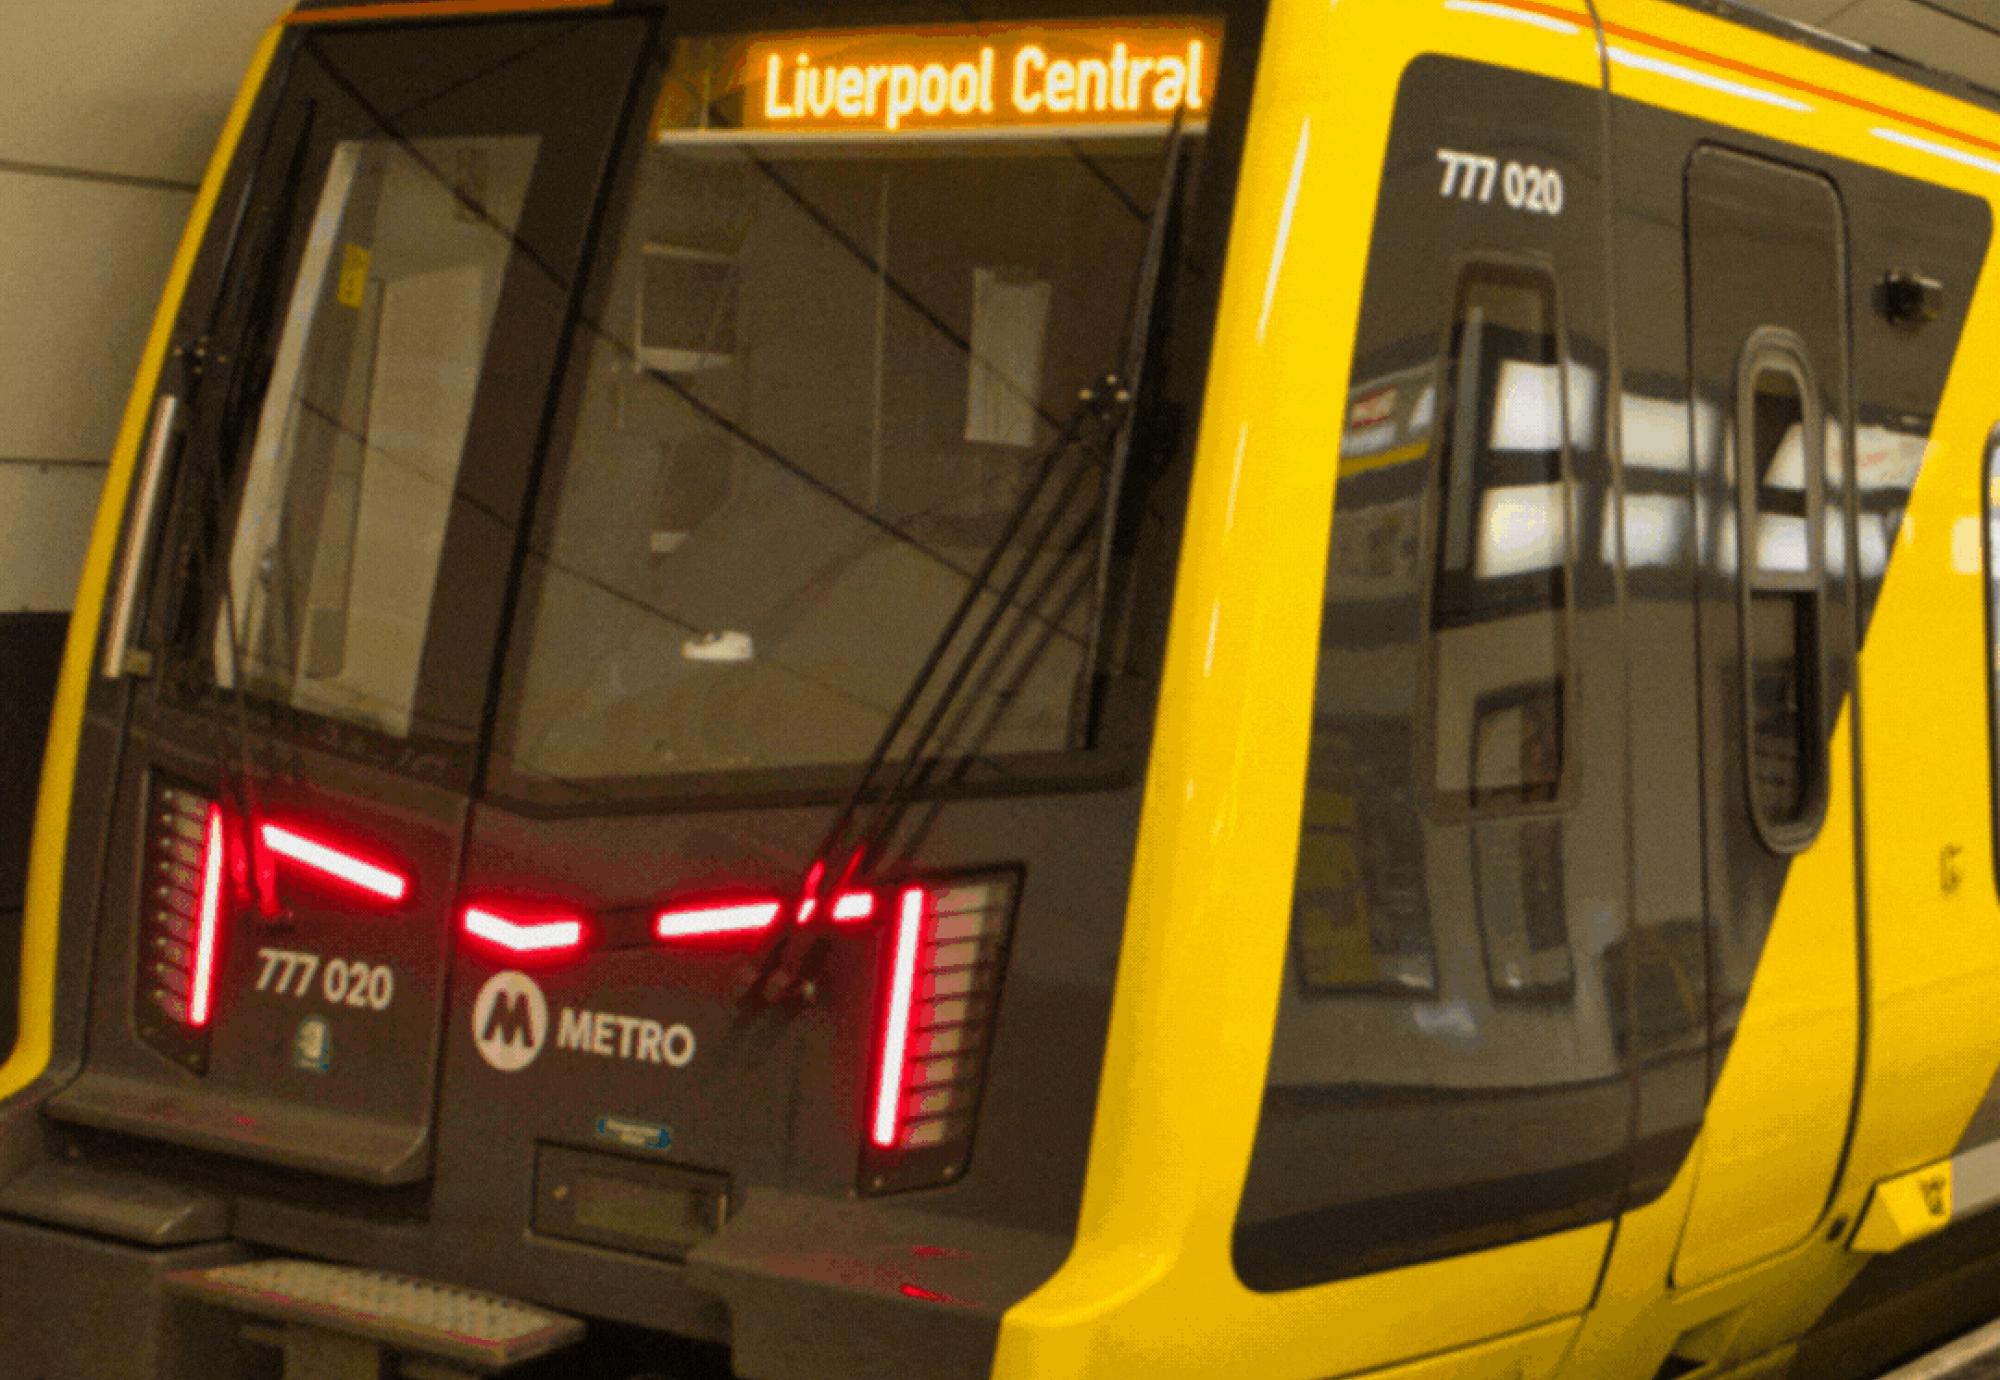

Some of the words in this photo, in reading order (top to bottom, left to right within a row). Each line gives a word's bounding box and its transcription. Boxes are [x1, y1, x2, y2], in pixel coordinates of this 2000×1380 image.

[764, 46, 995, 131] Liverpool
[1012, 39, 1203, 113] Central
[1436, 148, 1498, 202] 777
[1502, 161, 1563, 216] 020
[255, 948, 321, 998] 777
[322, 957, 395, 1012] 020
[556, 1006, 697, 1068] METRO
